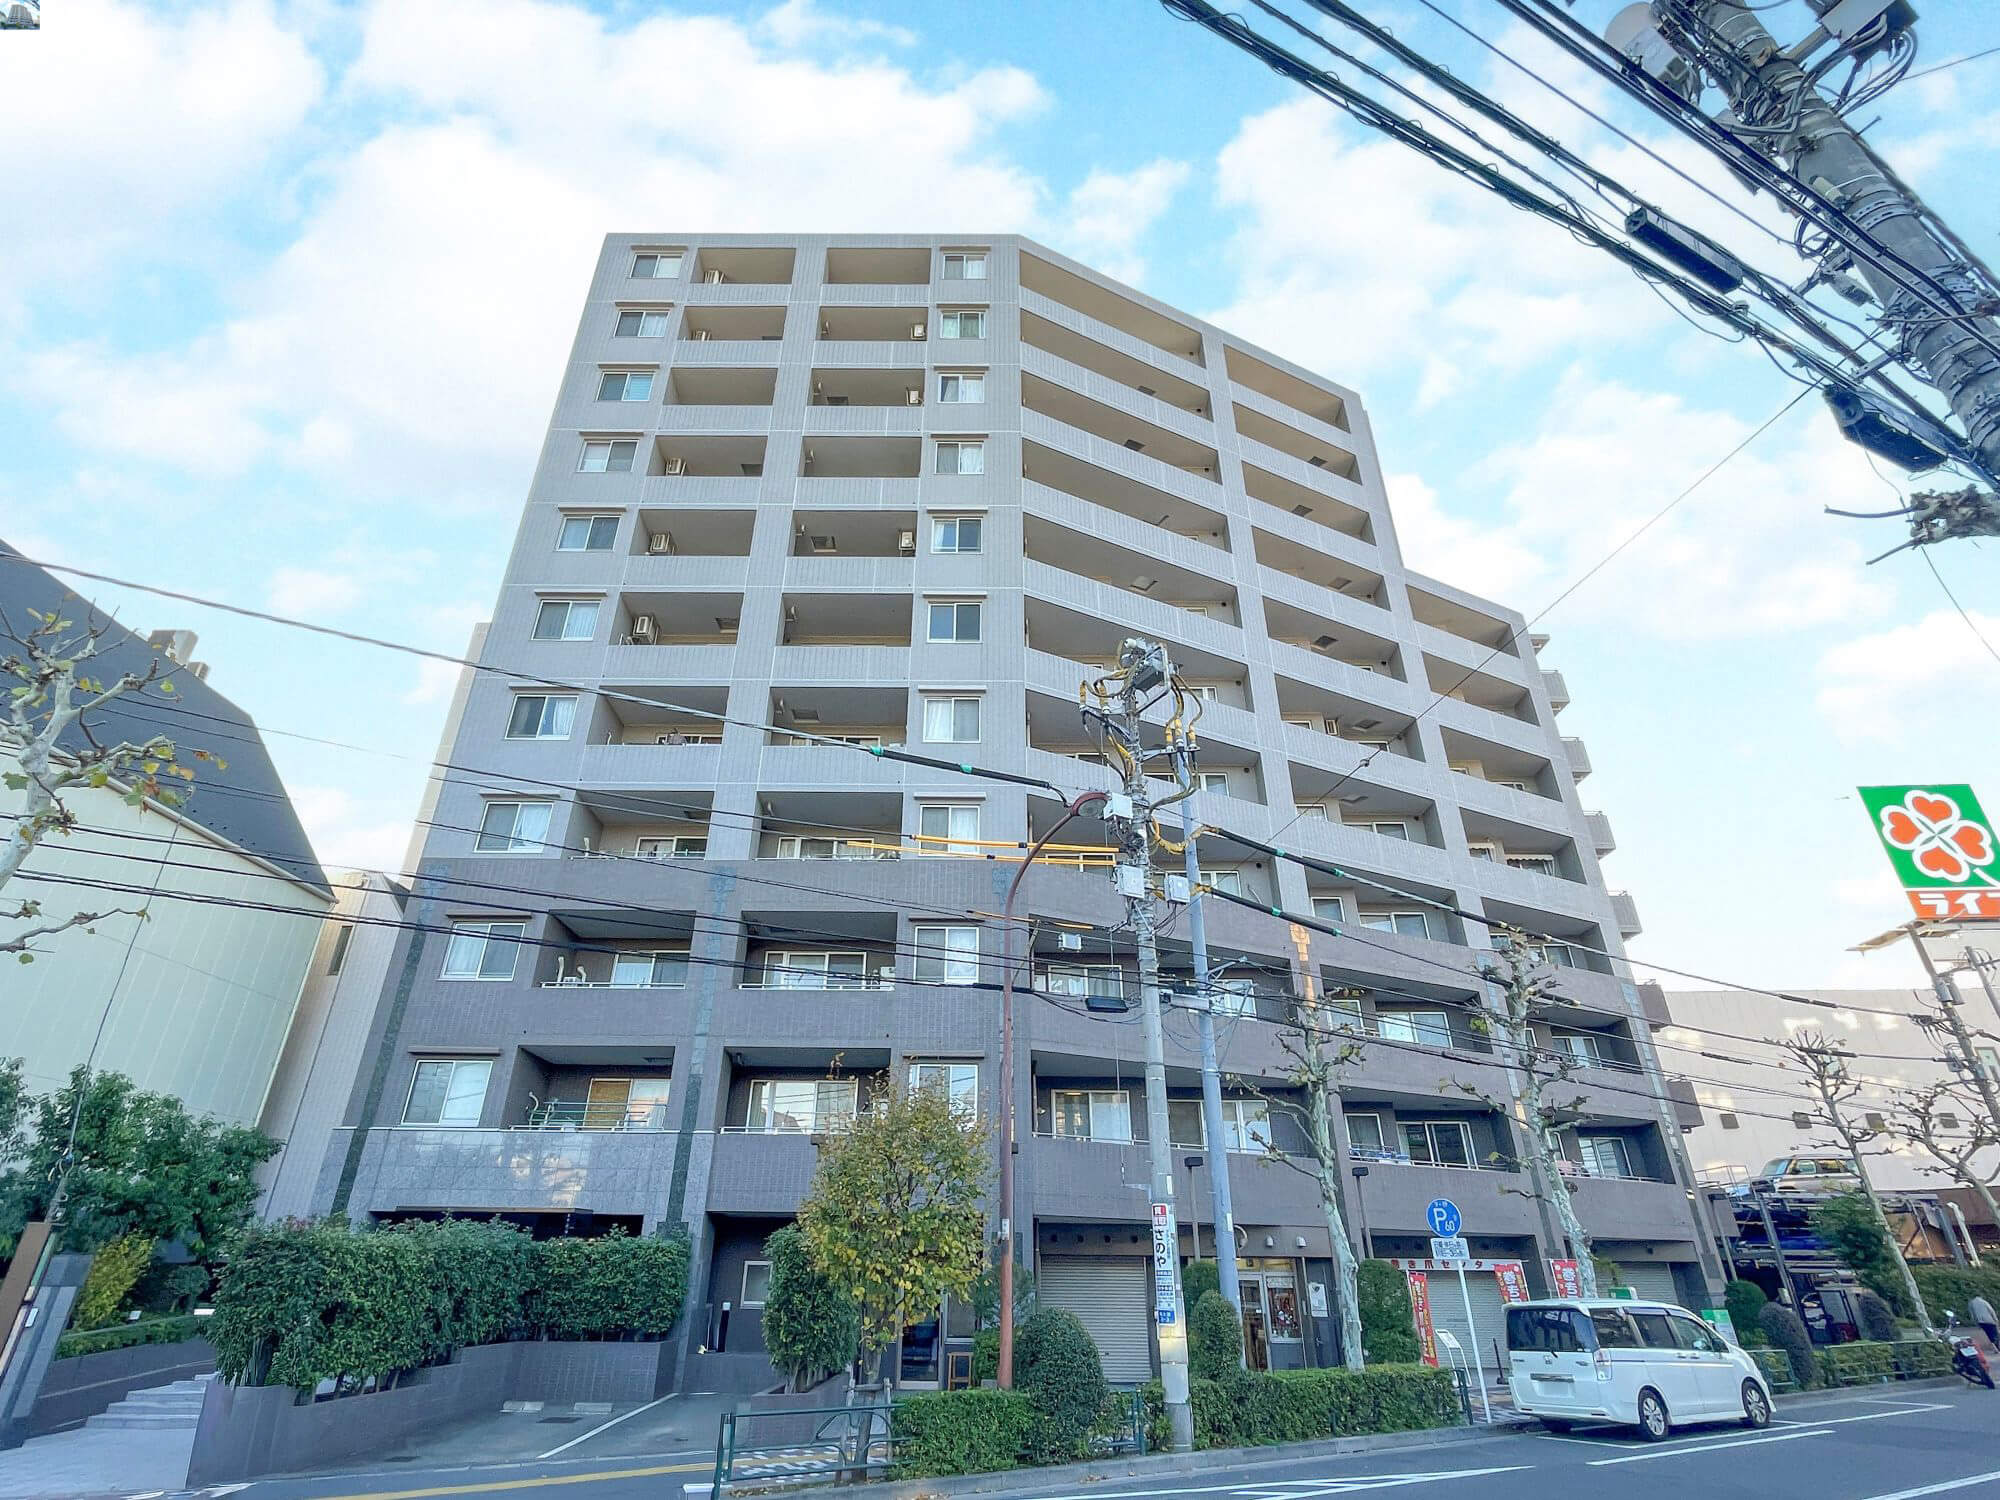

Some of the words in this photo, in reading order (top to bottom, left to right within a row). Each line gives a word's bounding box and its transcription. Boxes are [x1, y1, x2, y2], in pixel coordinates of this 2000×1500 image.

[1433, 1207, 1447, 1231] P
[1445, 1220, 1456, 1232] 60
[1155, 1229, 1166, 1267] さのや
